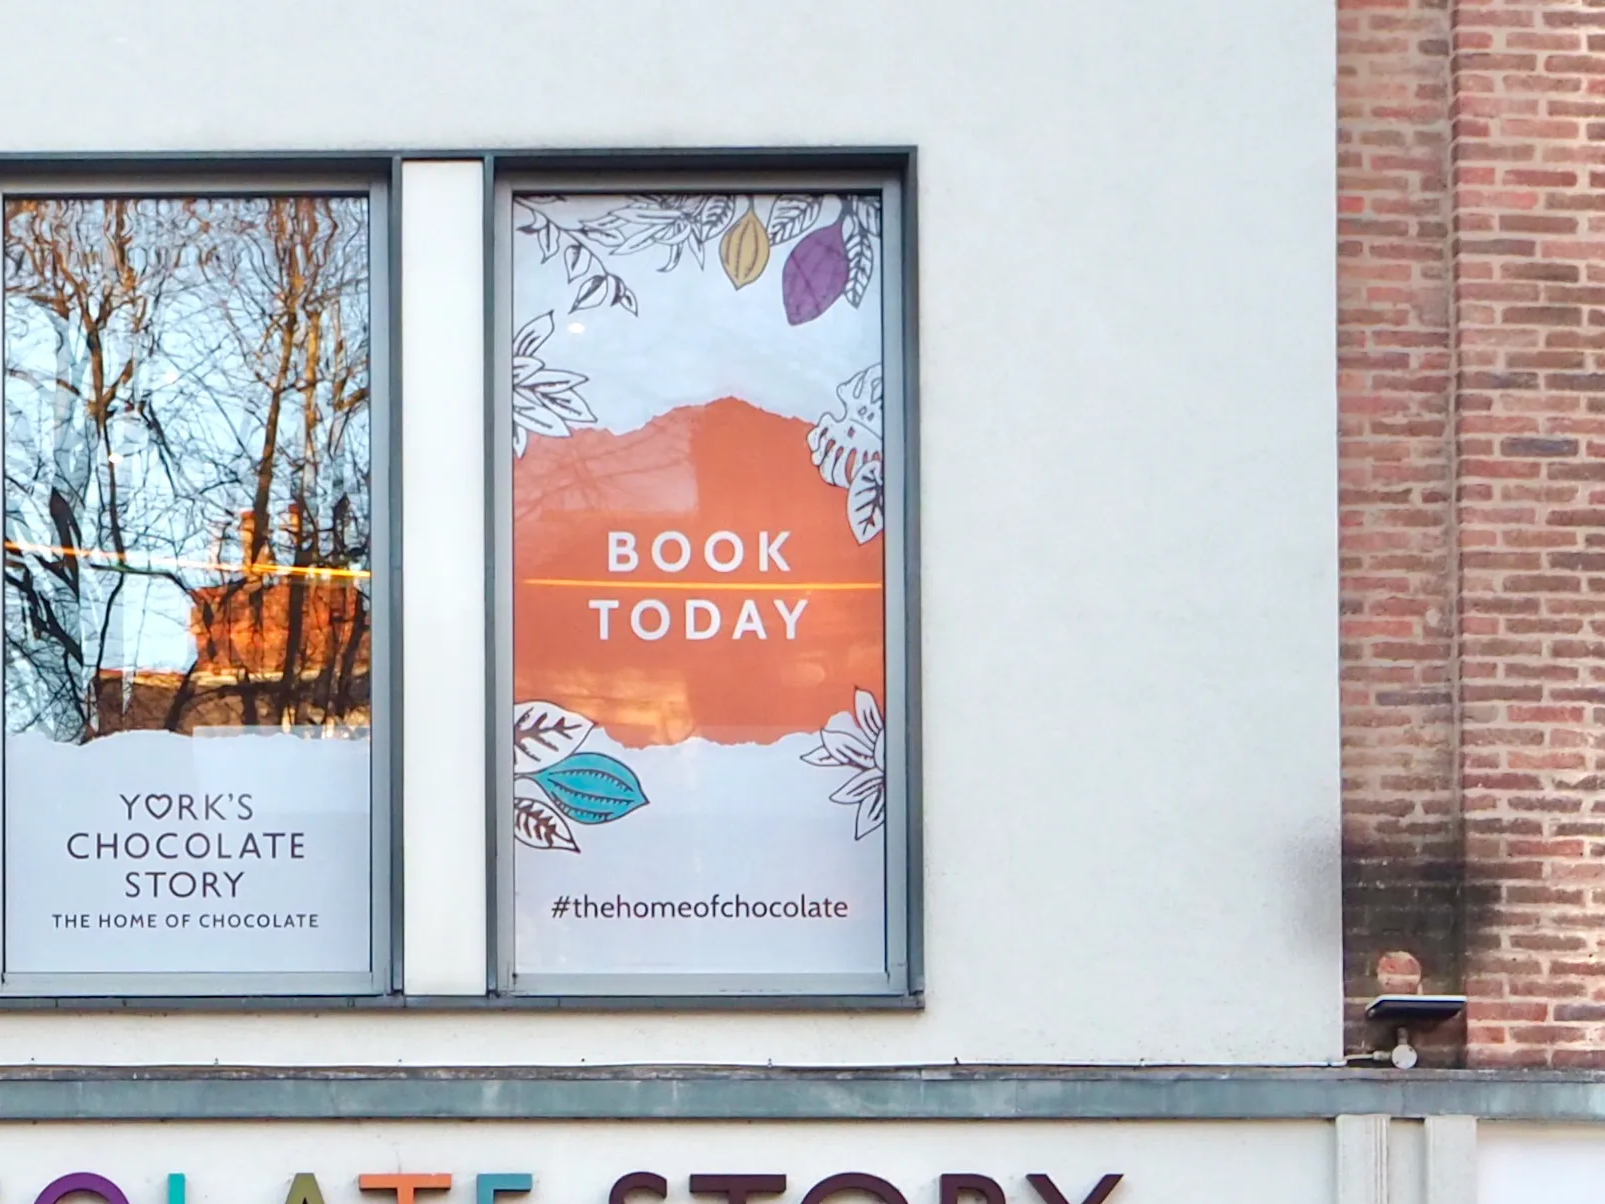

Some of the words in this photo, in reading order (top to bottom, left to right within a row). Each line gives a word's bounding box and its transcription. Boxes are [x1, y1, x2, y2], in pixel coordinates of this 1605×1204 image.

[607, 530, 792, 573] BOOK
[588, 598, 810, 641] TODAY
[66, 831, 306, 860] CHOCOLATE
[123, 870, 245, 900] STORY
[52, 912, 95, 929] THE
[98, 912, 159, 929] HOME
[164, 912, 192, 929] OF
[198, 912, 320, 929] CHOCOLATE
[551, 893, 849, 920] #thehomeofchocolate
